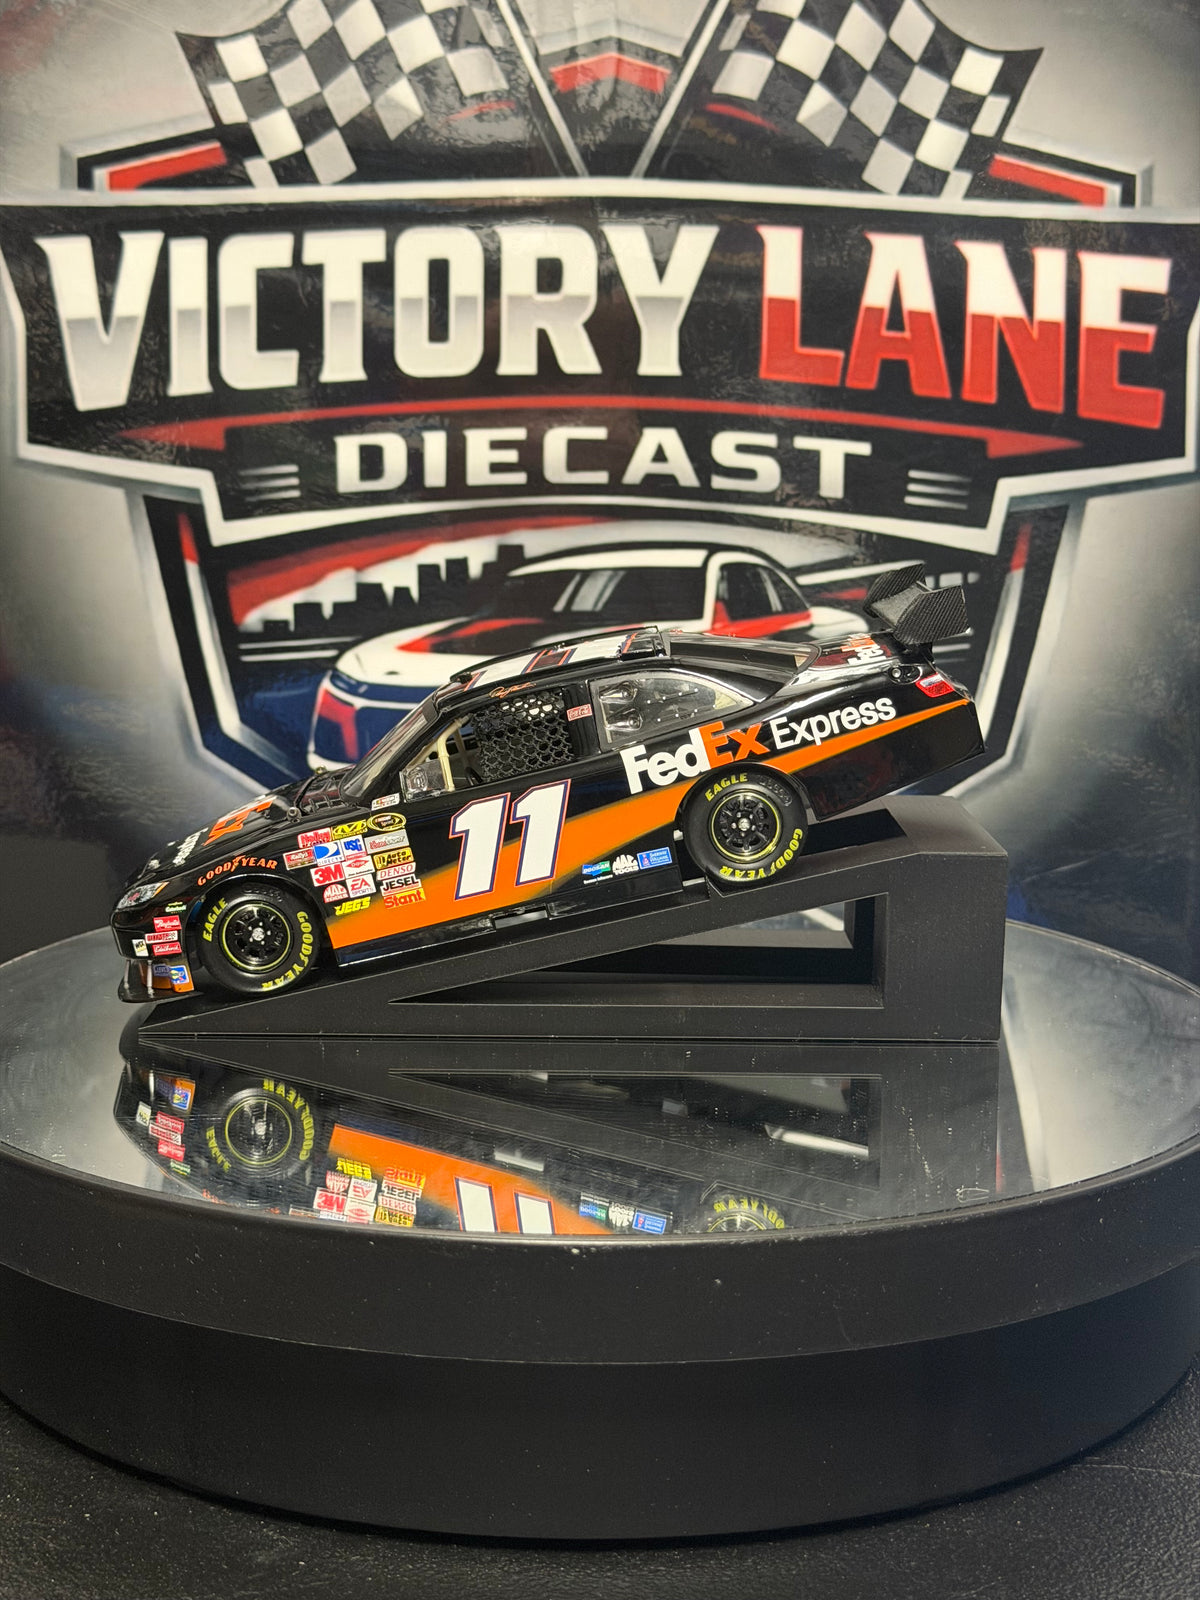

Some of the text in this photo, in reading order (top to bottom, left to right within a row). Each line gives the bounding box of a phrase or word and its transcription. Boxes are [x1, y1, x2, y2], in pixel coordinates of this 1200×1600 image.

[34, 224, 1172, 430] VICTORY LANE
[334, 427, 872, 499] DIECAST
[619, 720, 770, 795] FedEx
[770, 697, 897, 746] Express
[705, 773, 748, 801] EAGLE
[449, 779, 571, 901] 11
[720, 828, 803, 880] GOODYEAR
[197, 855, 278, 886] GOODYEAR
[314, 863, 345, 885] 3M
[350, 878, 371, 891] EA
[380, 865, 414, 879] DENSO
[383, 876, 419, 891] JESEL
[384, 889, 424, 908] Stant
[203, 898, 228, 941] EAGLE
[262, 911, 314, 991] GOODYEAR
